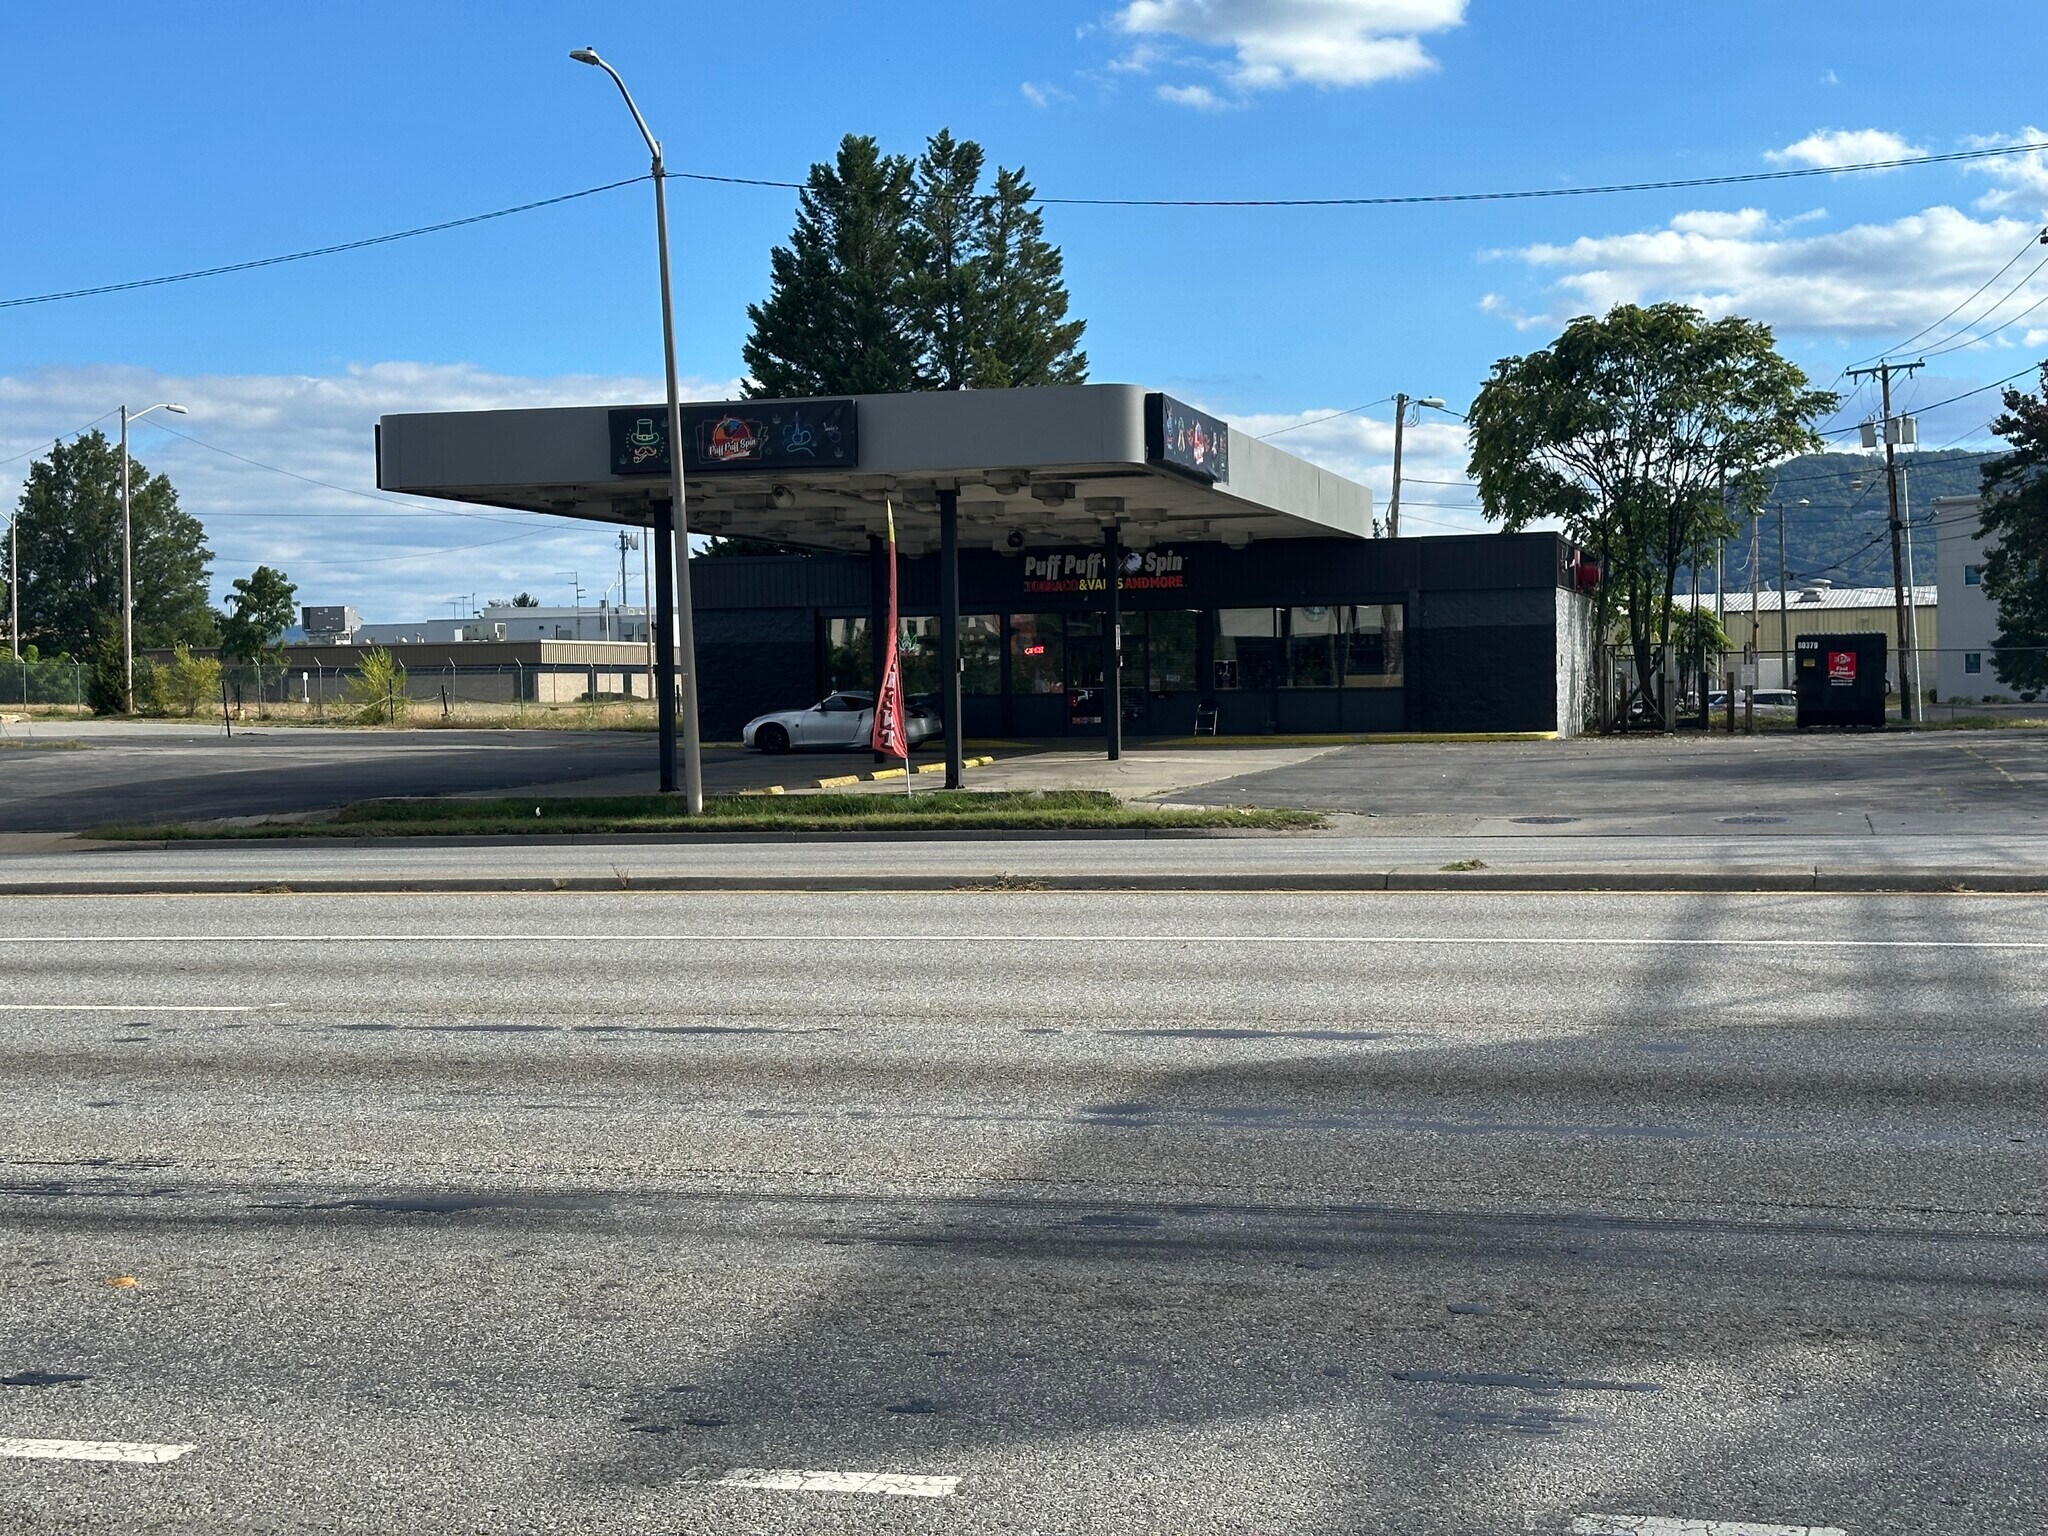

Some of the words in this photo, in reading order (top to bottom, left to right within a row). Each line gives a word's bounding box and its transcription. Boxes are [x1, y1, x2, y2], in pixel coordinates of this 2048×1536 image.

[710, 445, 723, 456] Puff
[725, 440, 738, 452] Puff
[740, 438, 756, 450] Spin
[1025, 555, 1061, 580] Puff
[1065, 553, 1101, 579] Puff
[1145, 549, 1183, 576] Spin
